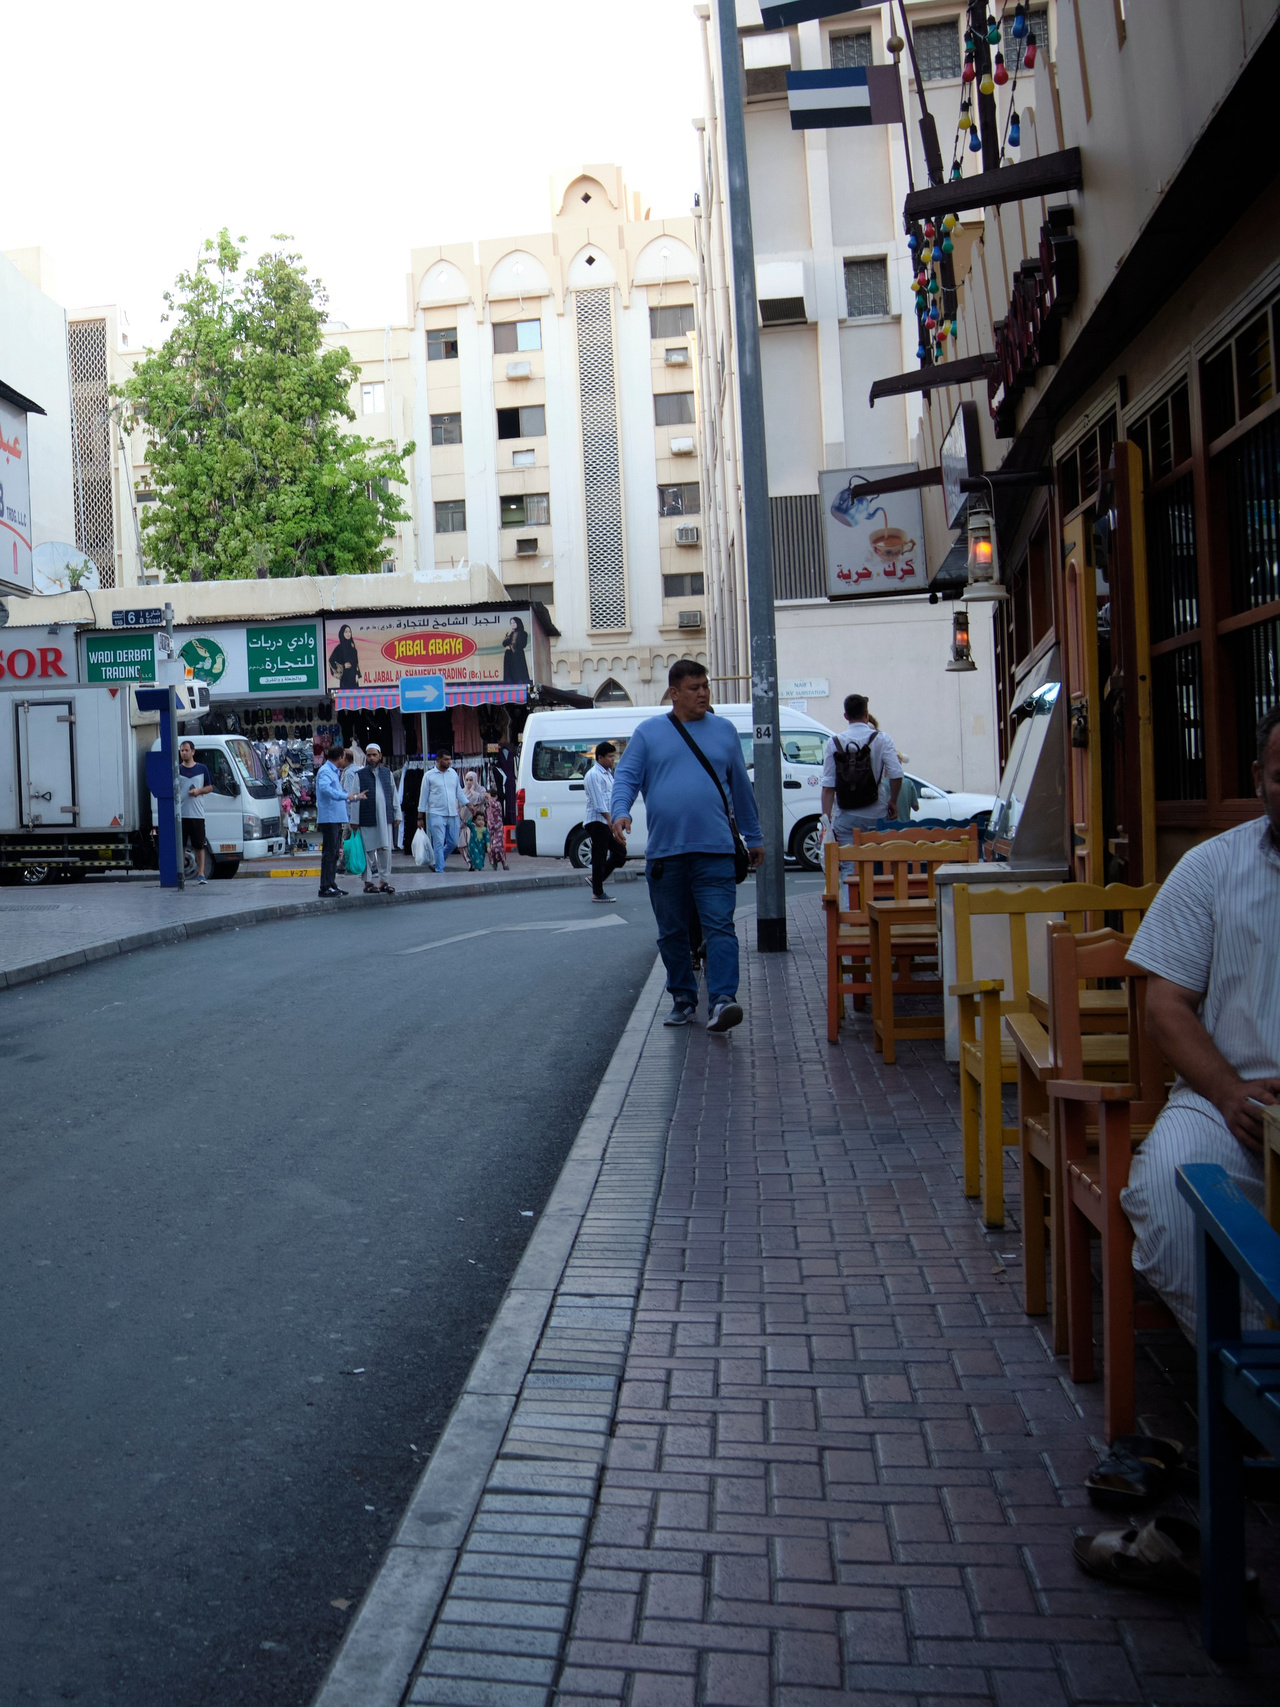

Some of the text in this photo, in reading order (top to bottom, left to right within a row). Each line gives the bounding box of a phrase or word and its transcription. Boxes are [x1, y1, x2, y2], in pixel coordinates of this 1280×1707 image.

[883, 558, 916, 581] كرك
[127, 611, 136, 624] 6
[396, 618, 430, 630] للتجارة
[432, 616, 468, 630] الشامخ
[471, 615, 501, 627] الجبل
[248, 632, 315, 652] وادي دربات
[394, 637, 464, 660] JABAL ABAYA
[88, 648, 153, 664] WADI DERBAT
[265, 654, 315, 673] للتجارة
[363, 672, 372, 683] AL
[373, 670, 394, 683] JABAL
[483, 670, 500, 679] L.L.C
[756, 726, 772, 739] 84
